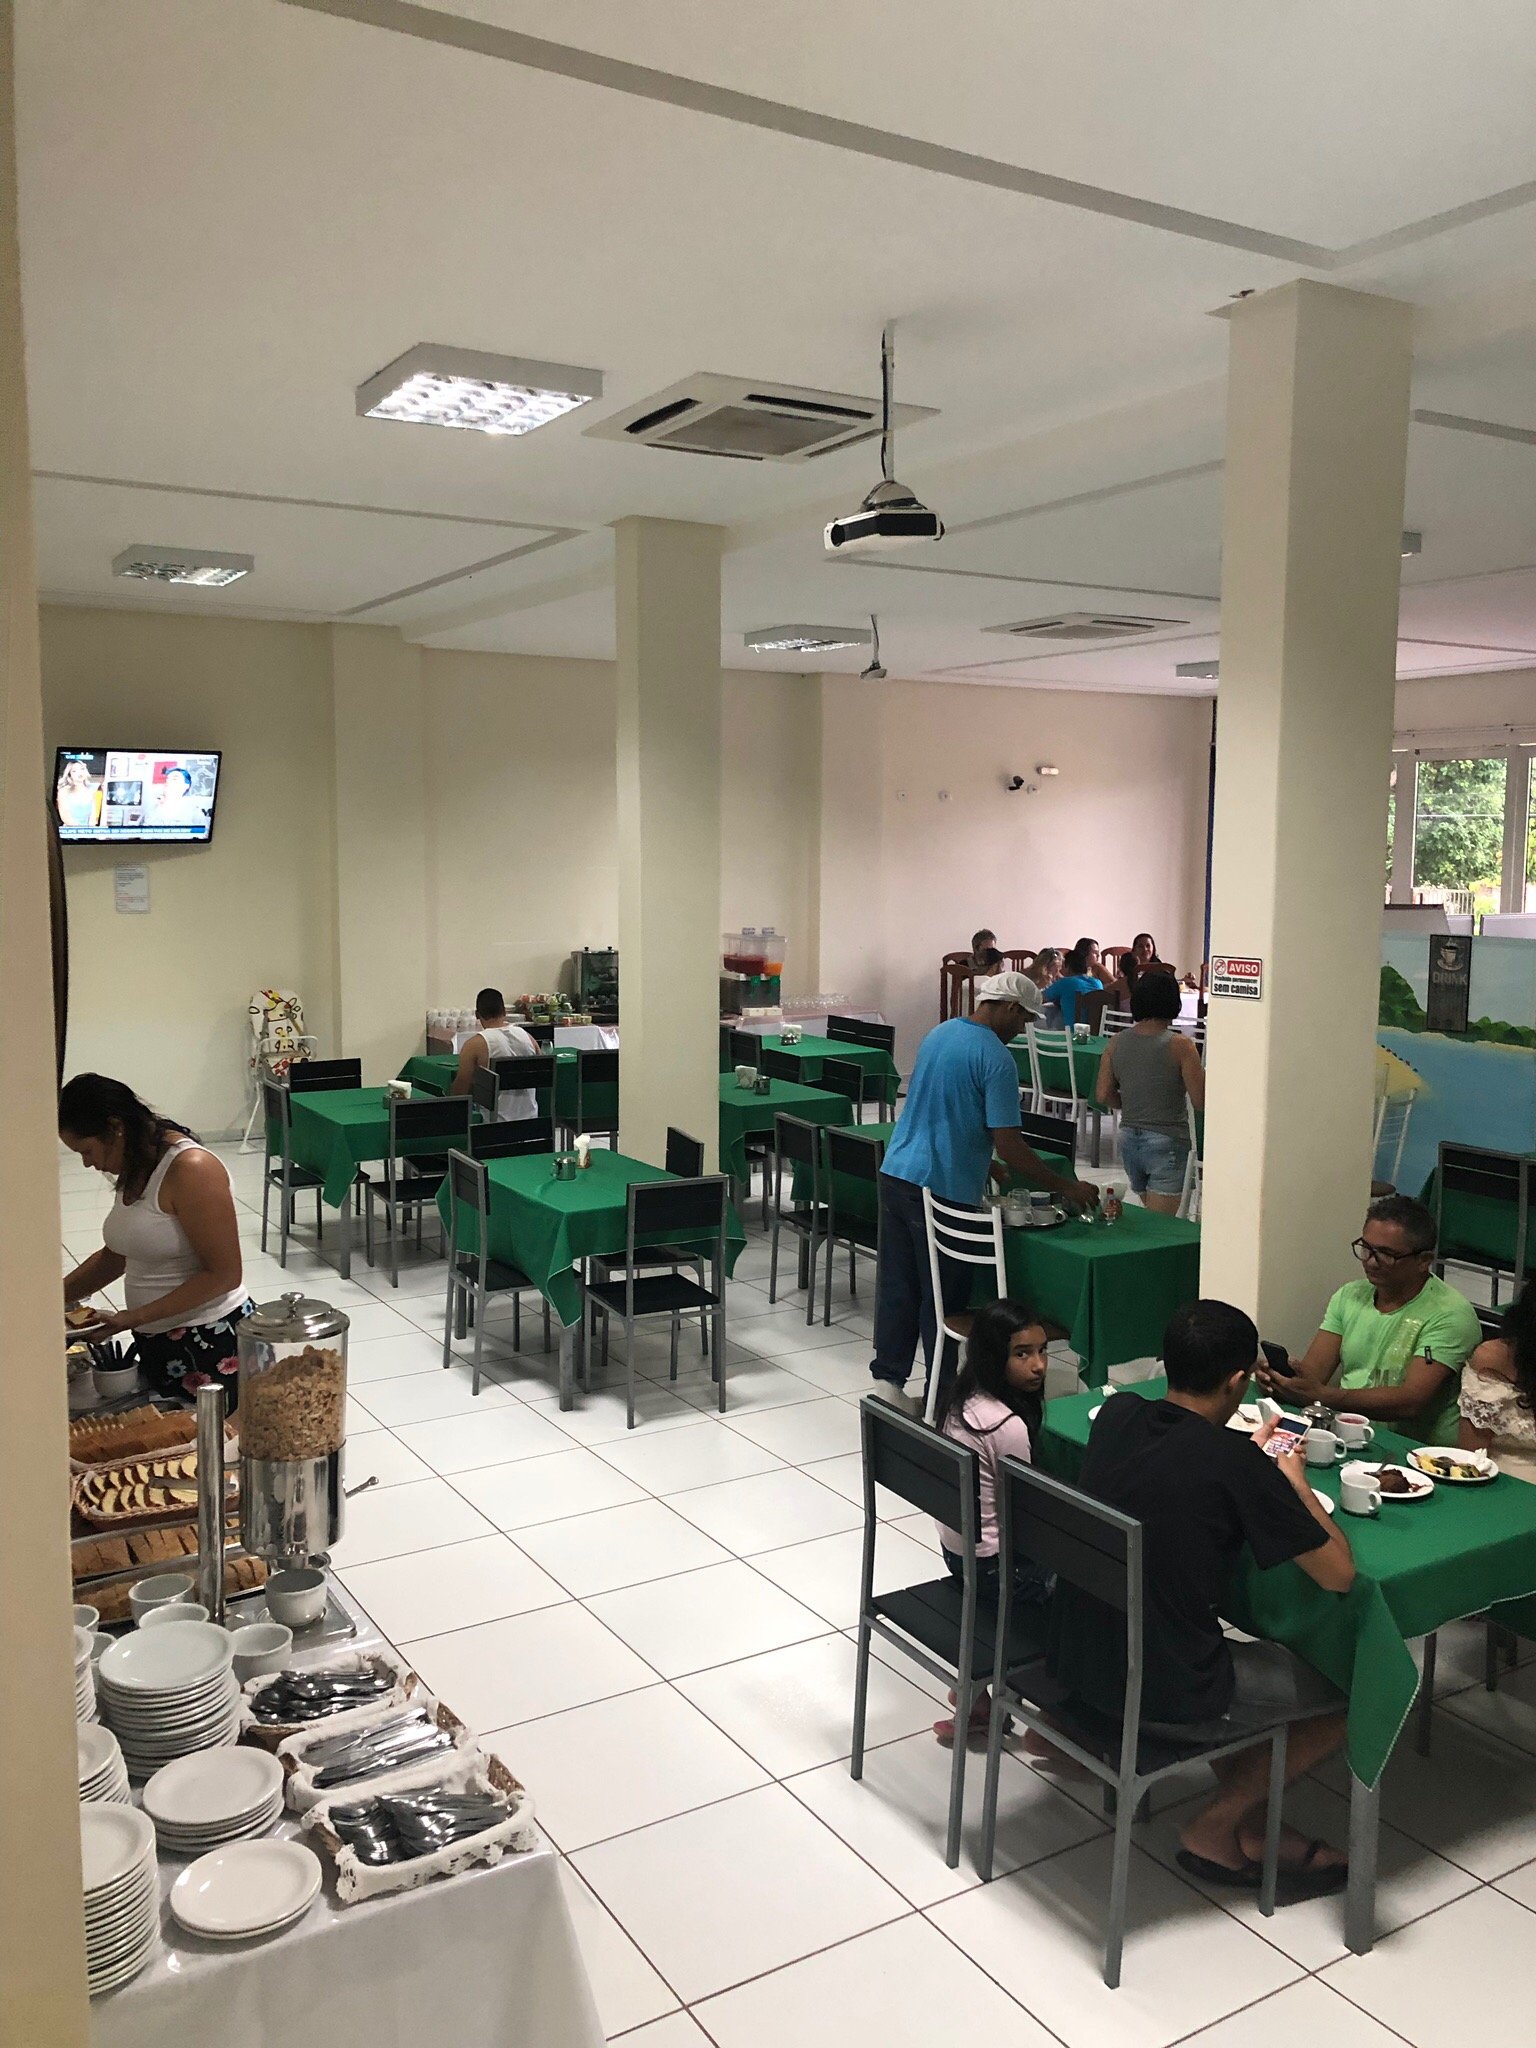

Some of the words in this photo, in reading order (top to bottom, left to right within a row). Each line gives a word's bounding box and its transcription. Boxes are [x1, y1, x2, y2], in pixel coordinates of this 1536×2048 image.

[1229, 963, 1258, 974] AVISO
[1214, 983, 1229, 993] sem
[1231, 984, 1258, 995] camisa
